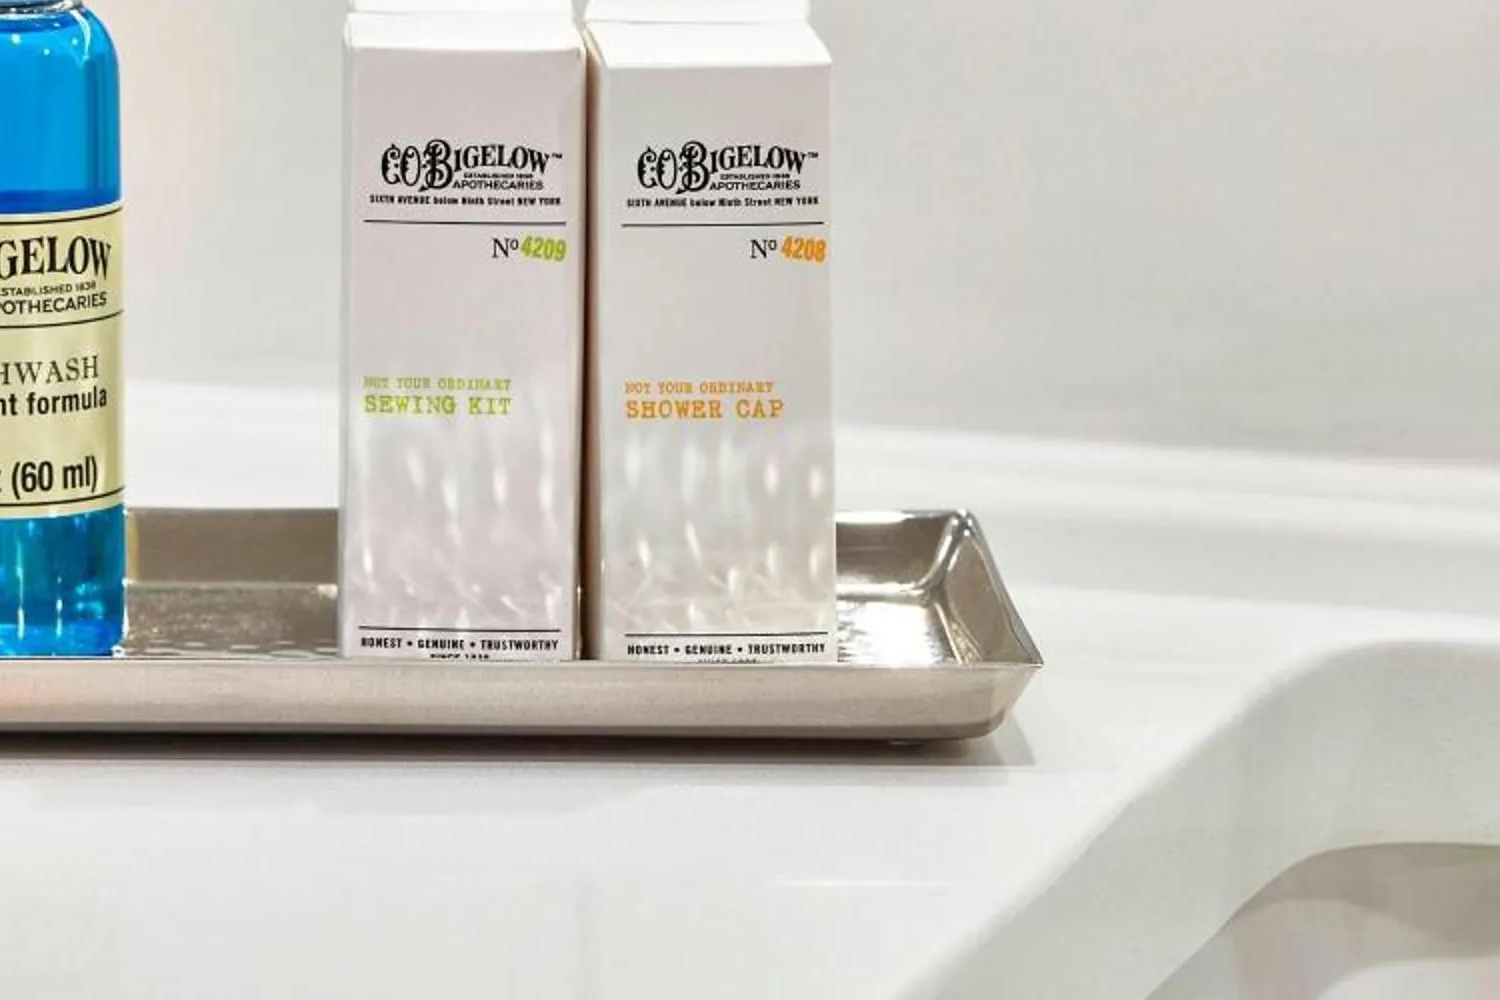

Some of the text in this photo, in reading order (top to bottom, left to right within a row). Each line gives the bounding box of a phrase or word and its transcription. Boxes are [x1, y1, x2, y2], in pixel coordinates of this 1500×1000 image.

[418, 139, 550, 192] BIGELOW
[676, 140, 807, 195] BIGELOW
[452, 179, 545, 190] APOTHECARIES
[708, 179, 801, 191] APOTHECARIES
[369, 194, 395, 204] SIXTH
[397, 194, 430, 204] AVENUE
[517, 195, 537, 205] NEW
[539, 195, 561, 205] YORK
[774, 196, 793, 206] NEW
[796, 196, 819, 205] YORK
[521, 235, 567, 262] 4209
[781, 234, 827, 262] 4208
[363, 376, 512, 390] NOT YOUR ORDINARY
[624, 381, 774, 393] NOT YOUR ORDINARY
[26, 385, 107, 415] formula
[364, 395, 512, 415] SEWING KIT
[626, 399, 785, 418] SHOWER CAP
[12, 460, 53, 500] (60
[62, 455, 98, 493] ml)
[361, 637, 559, 650] HONEST GENUINE TRUSTWORTHY
[627, 643, 825, 655] HONEST GENUINE TRUSTWORTHY
